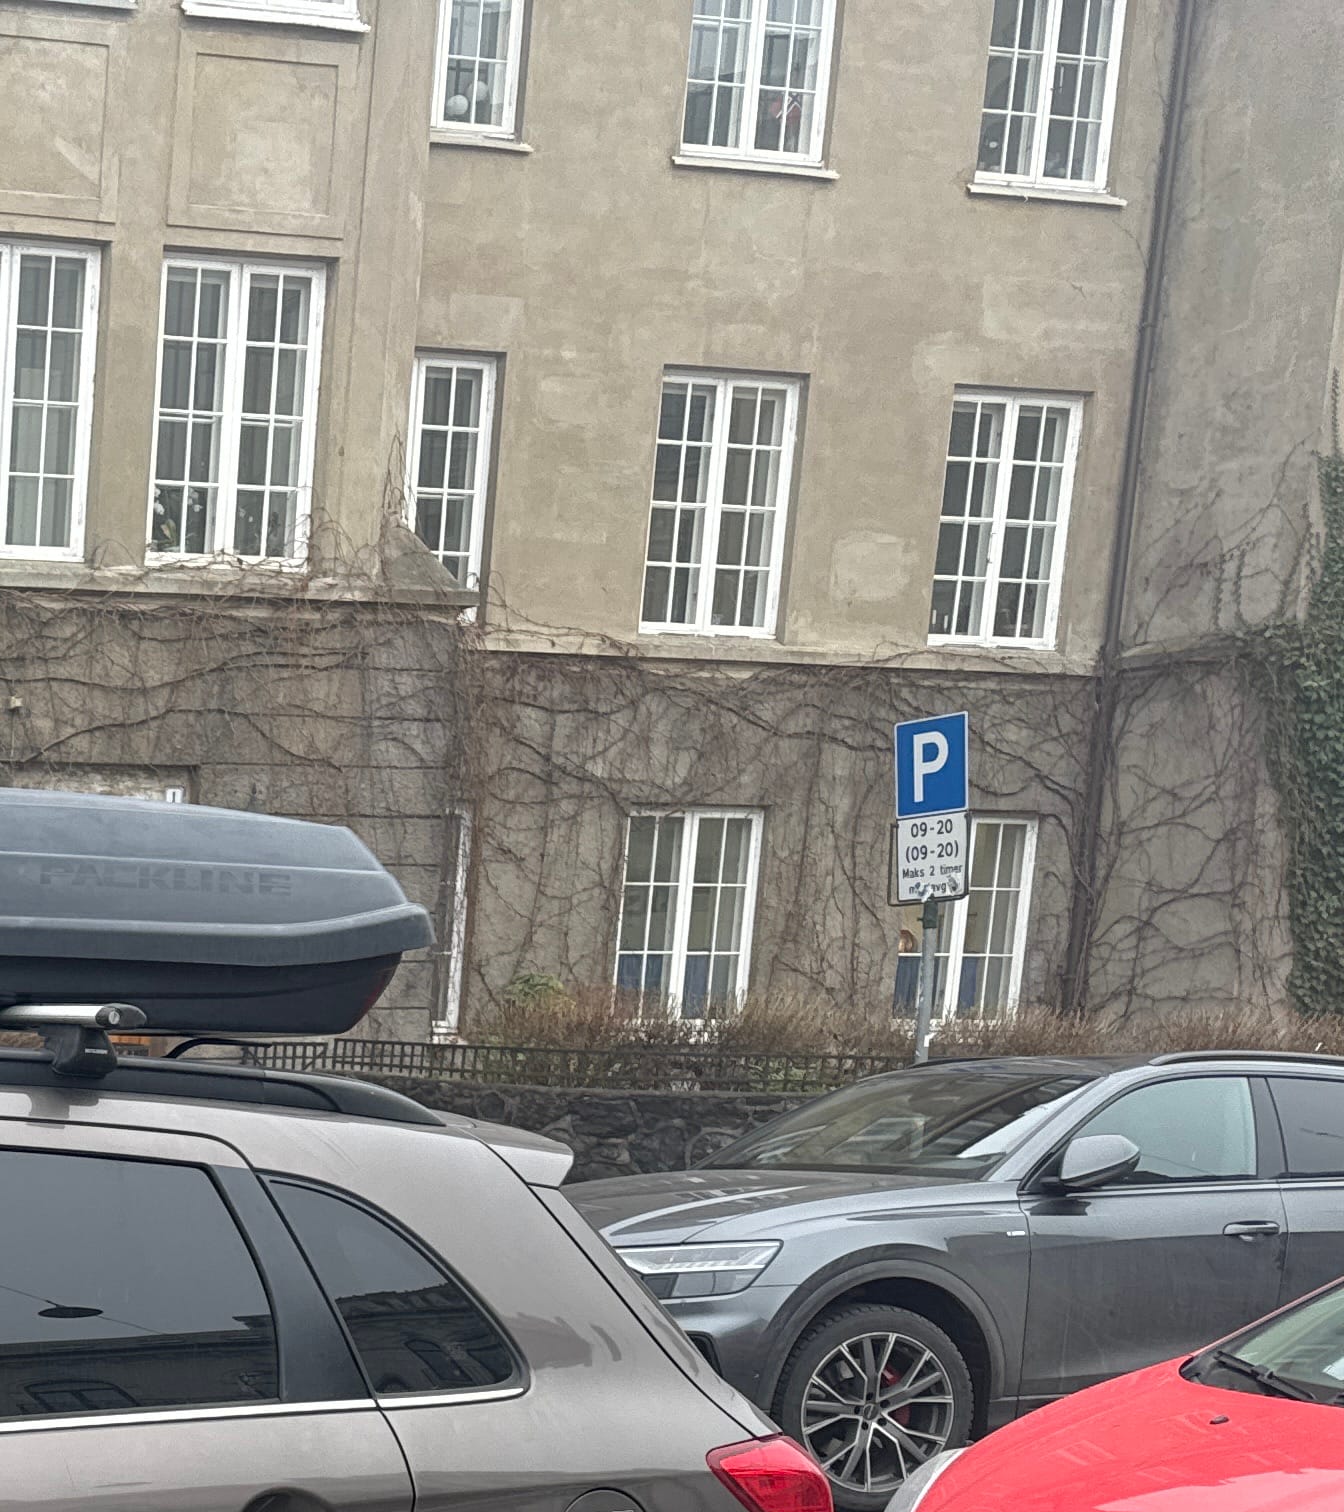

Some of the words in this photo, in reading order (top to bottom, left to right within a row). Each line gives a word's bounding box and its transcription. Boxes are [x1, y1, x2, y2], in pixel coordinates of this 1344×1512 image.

[913, 731, 949, 803] P
[39, 861, 293, 897] PACKLINE
[902, 867, 925, 879] Maks
[929, 865, 936, 877] 2
[940, 864, 963, 875] timer
